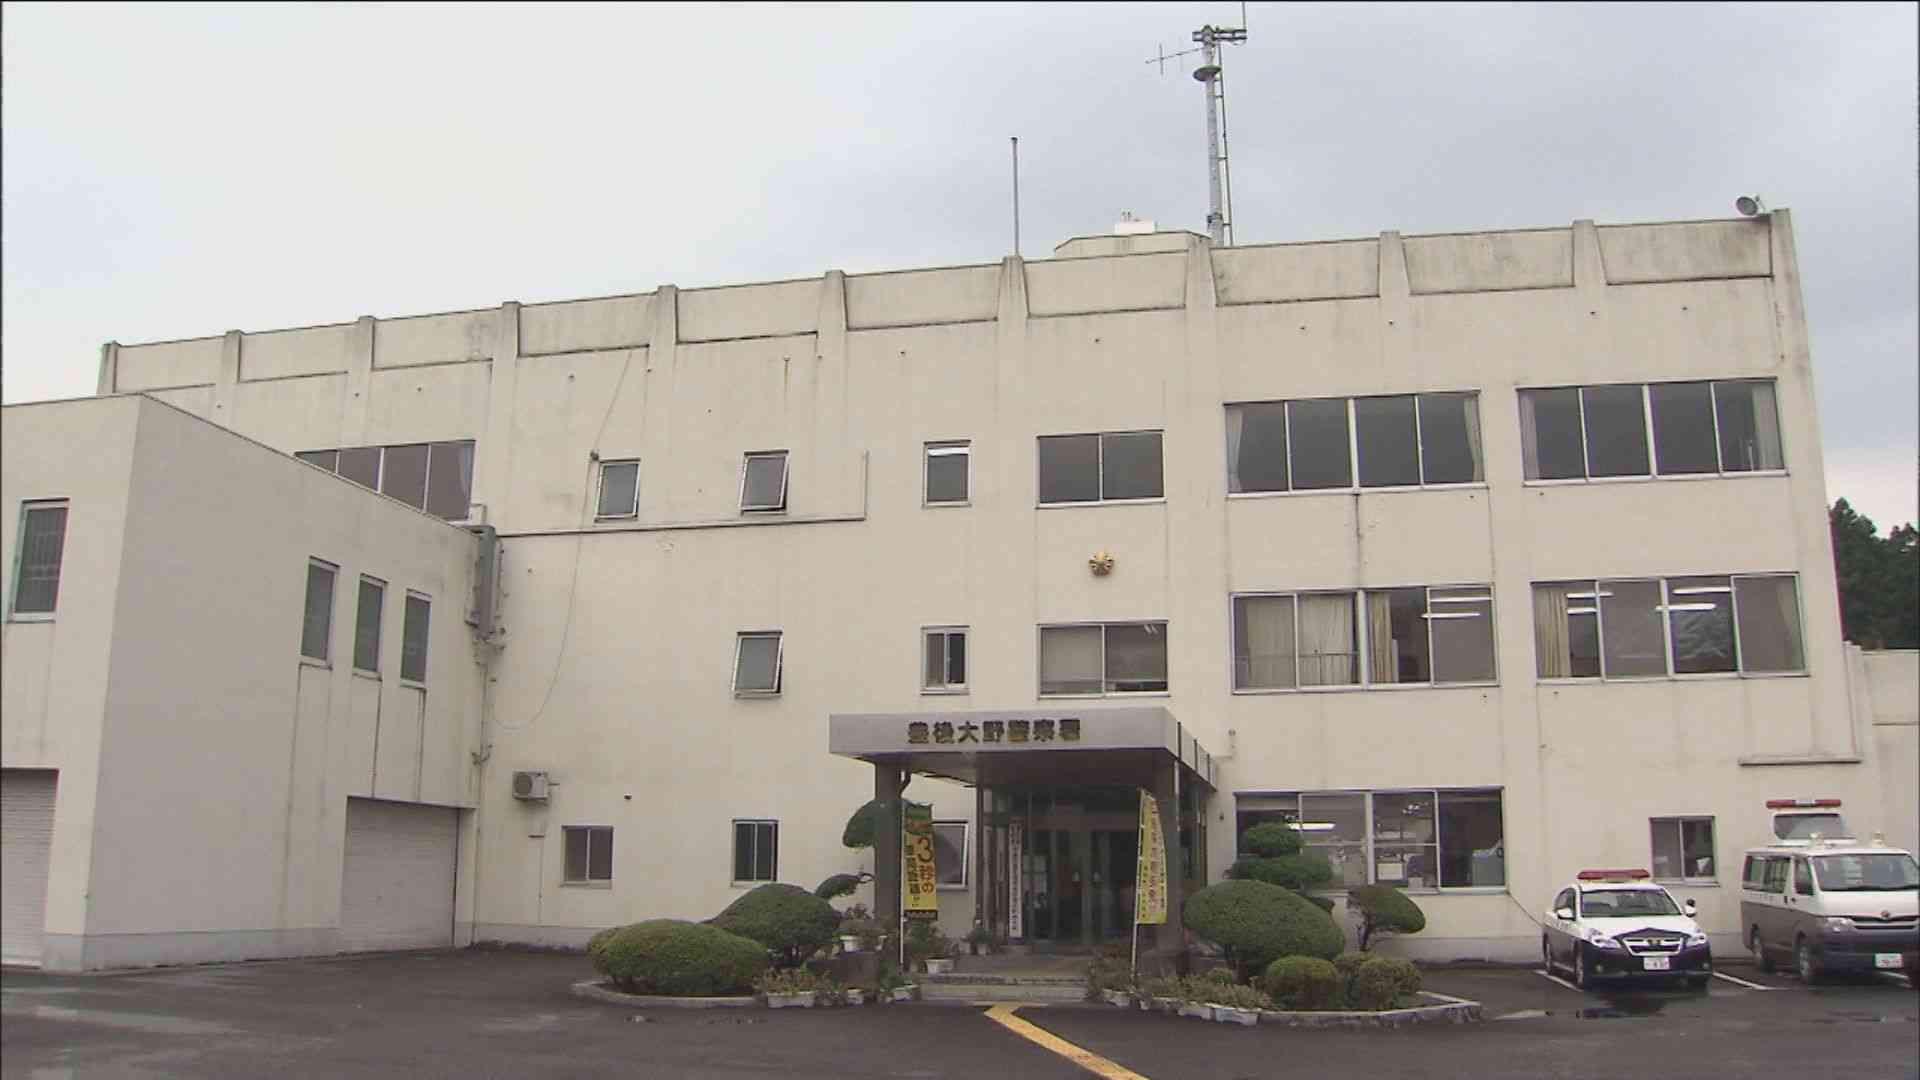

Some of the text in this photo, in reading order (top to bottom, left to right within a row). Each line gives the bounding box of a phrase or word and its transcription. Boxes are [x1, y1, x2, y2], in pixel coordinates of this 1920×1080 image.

[908, 719, 1081, 744] 豊後大野警察署
